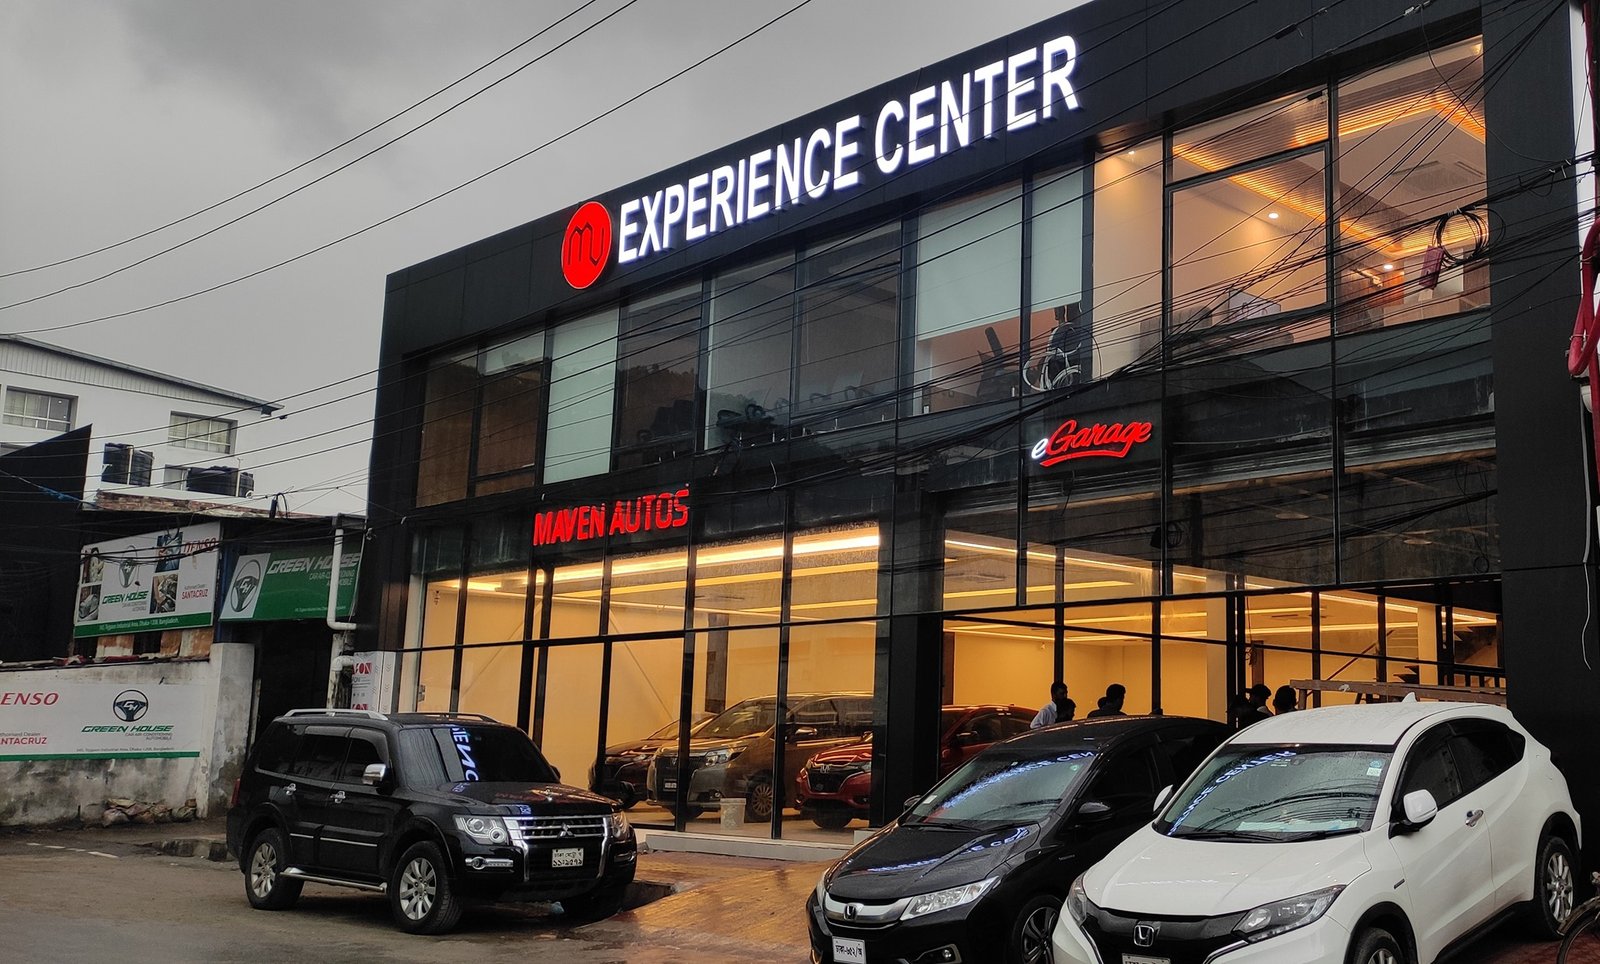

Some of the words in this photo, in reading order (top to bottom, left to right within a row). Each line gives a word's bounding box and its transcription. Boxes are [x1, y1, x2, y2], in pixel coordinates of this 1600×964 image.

[617, 114, 860, 264] EXPERIENCE
[874, 34, 1081, 174] CENTER
[533, 505, 606, 546] MAVEN
[609, 488, 690, 536] AUTOS
[267, 557, 315, 574] GREEN
[314, 553, 361, 570] HOSE
[102, 593, 126, 605] GREEN
[125, 590, 149, 601] HOUSE
[181, 588, 208, 600] SANTACRUZ
[0, 692, 59, 705] ENSO
[81, 725, 129, 733] GREEN
[0, 737, 47, 745] NTACRUZ
